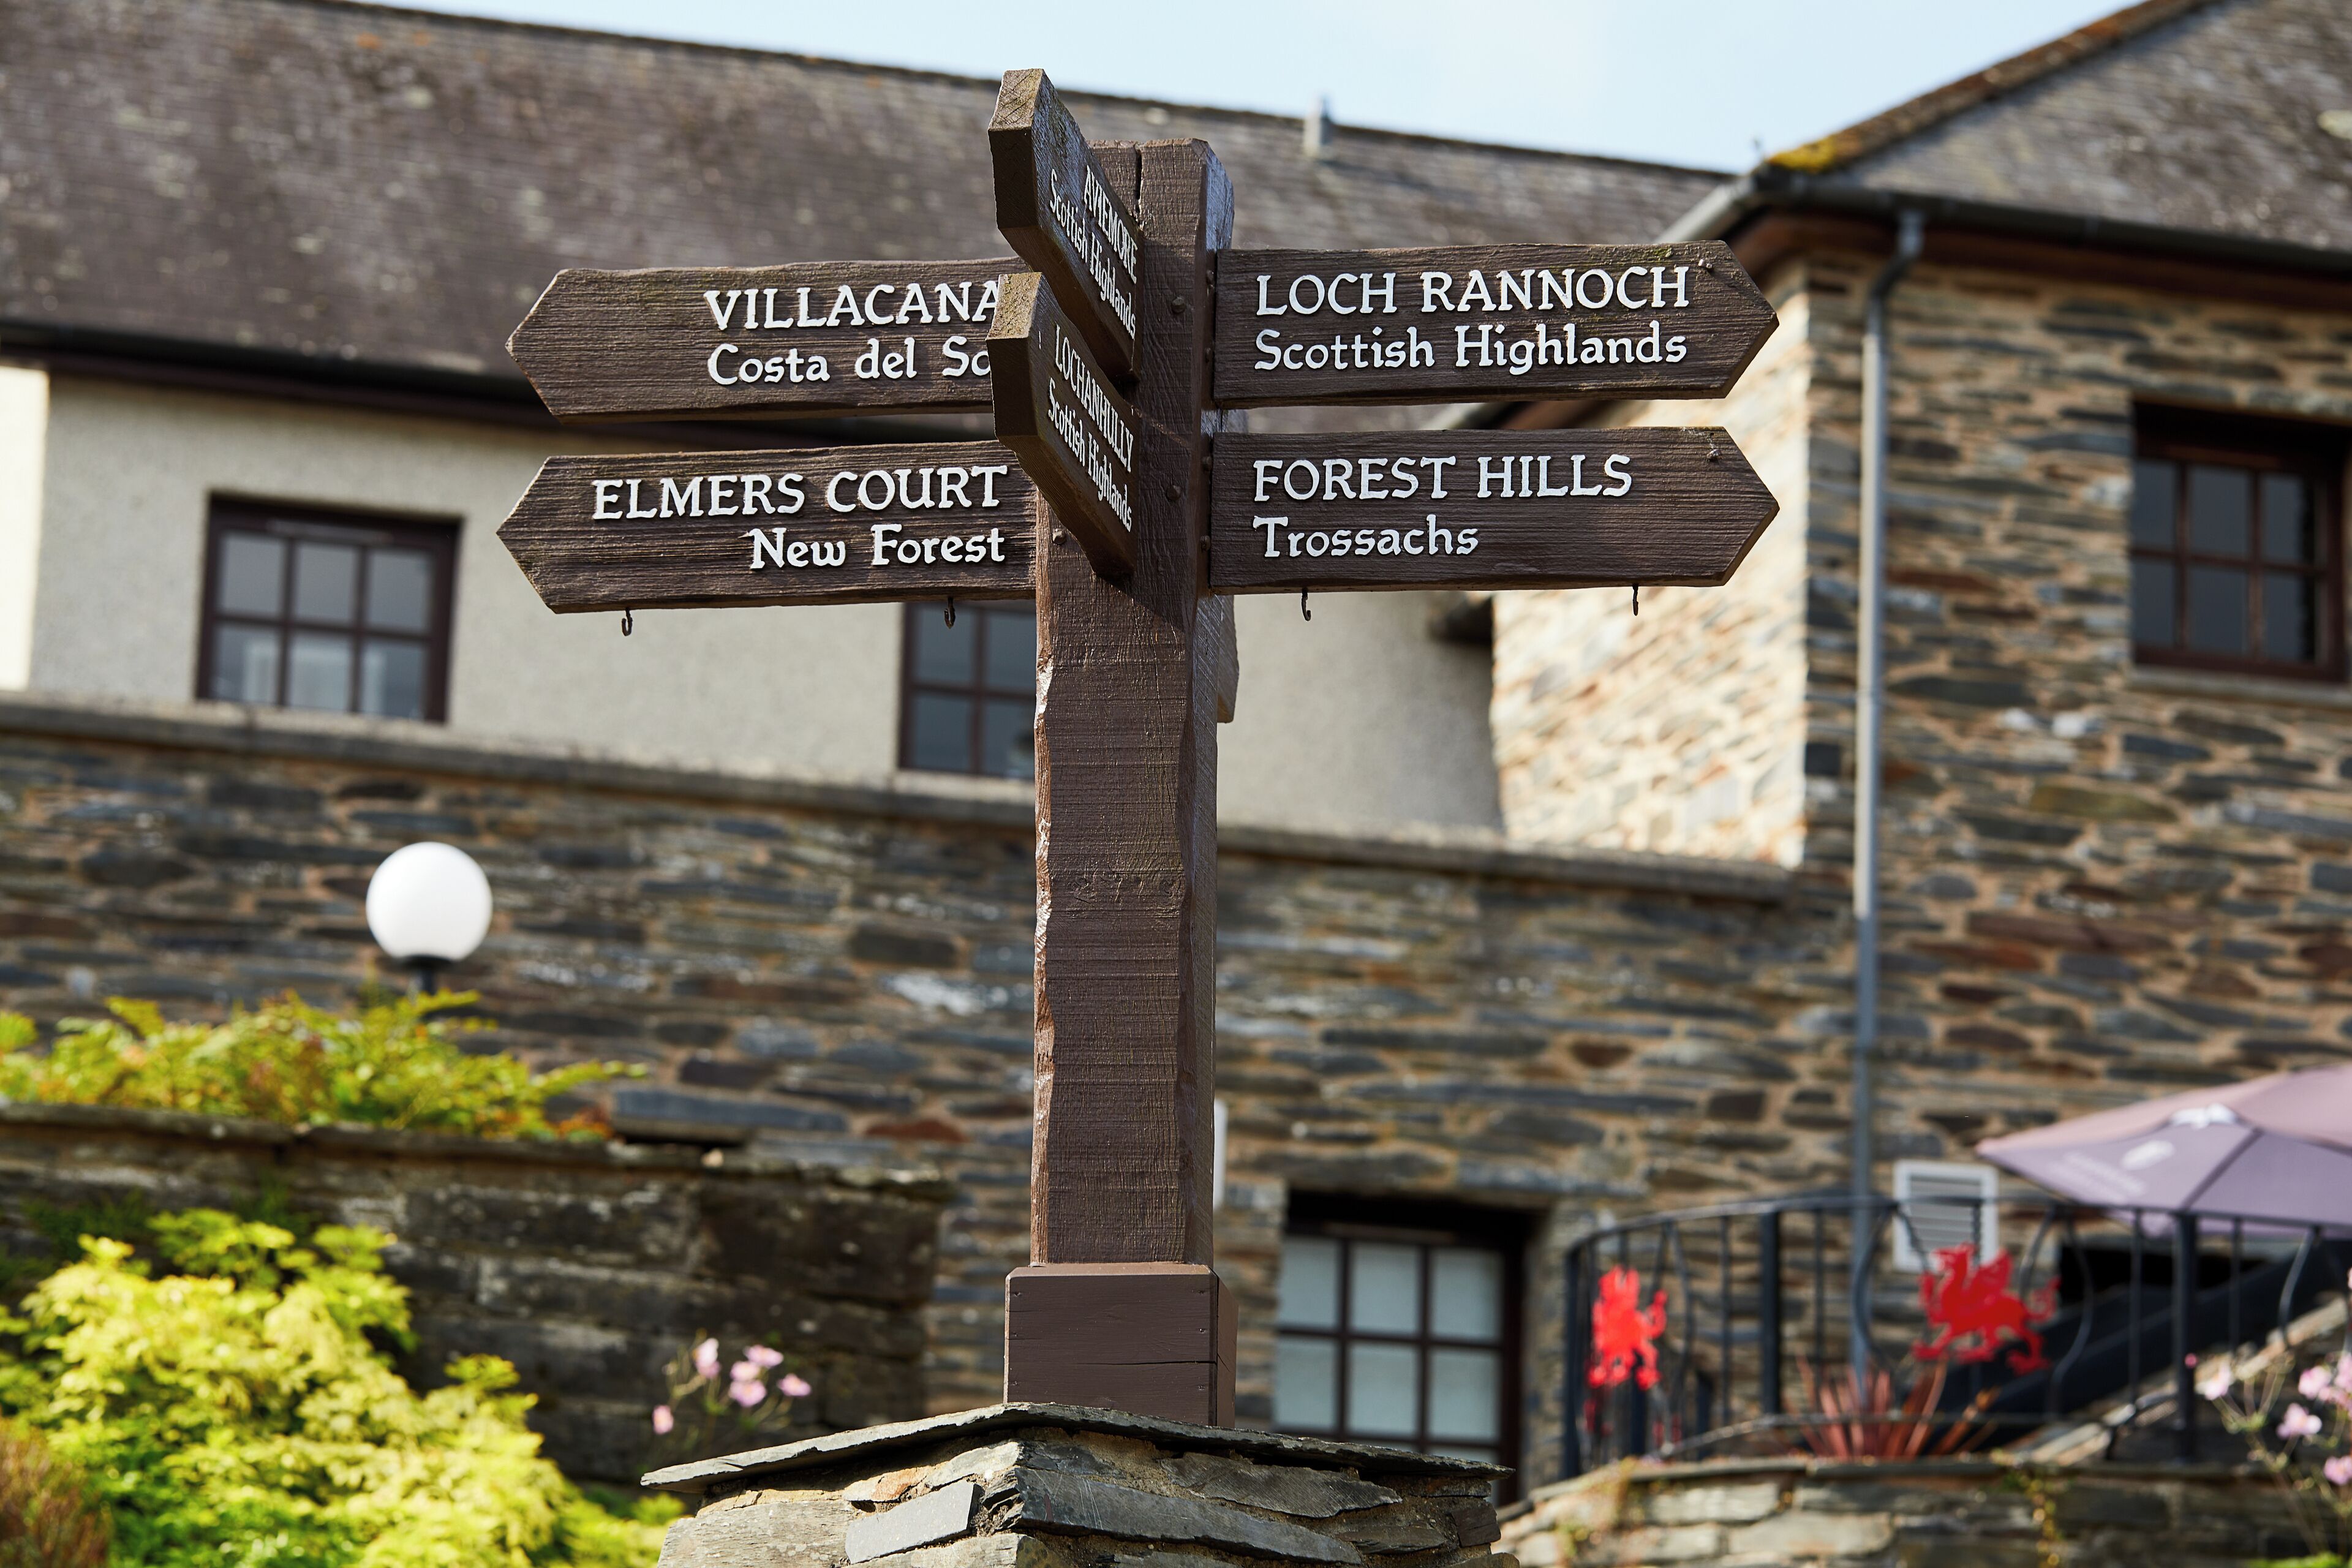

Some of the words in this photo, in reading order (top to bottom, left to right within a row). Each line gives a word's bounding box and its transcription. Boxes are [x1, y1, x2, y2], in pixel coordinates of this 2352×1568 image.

[1084, 165, 1138, 285] AVIEMORE
[1049, 168, 1087, 263] Scottish
[1090, 231, 1136, 340] Highlands
[703, 280, 1000, 330] VILLACANA
[1256, 272, 1398, 316] LOCH
[1419, 265, 1690, 313] RANNOCH
[707, 342, 831, 385] Costa
[854, 336, 918, 380] del
[941, 335, 992, 377] So
[1254, 326, 1436, 371] Scottish
[1455, 319, 1687, 376] Highlands
[1055, 325, 1134, 473] LOCHANHULLY
[1048, 377, 1086, 467] Scottish
[1087, 431, 1133, 532] Highlands
[1253, 455, 1457, 502] FOREST
[1477, 453, 1632, 498] HILLS
[592, 472, 805, 520] ELMERS
[826, 464, 1008, 513] COURT
[749, 527, 846, 570] New
[870, 523, 1006, 566] Forest
[1253, 514, 1479, 558] Trossachs
